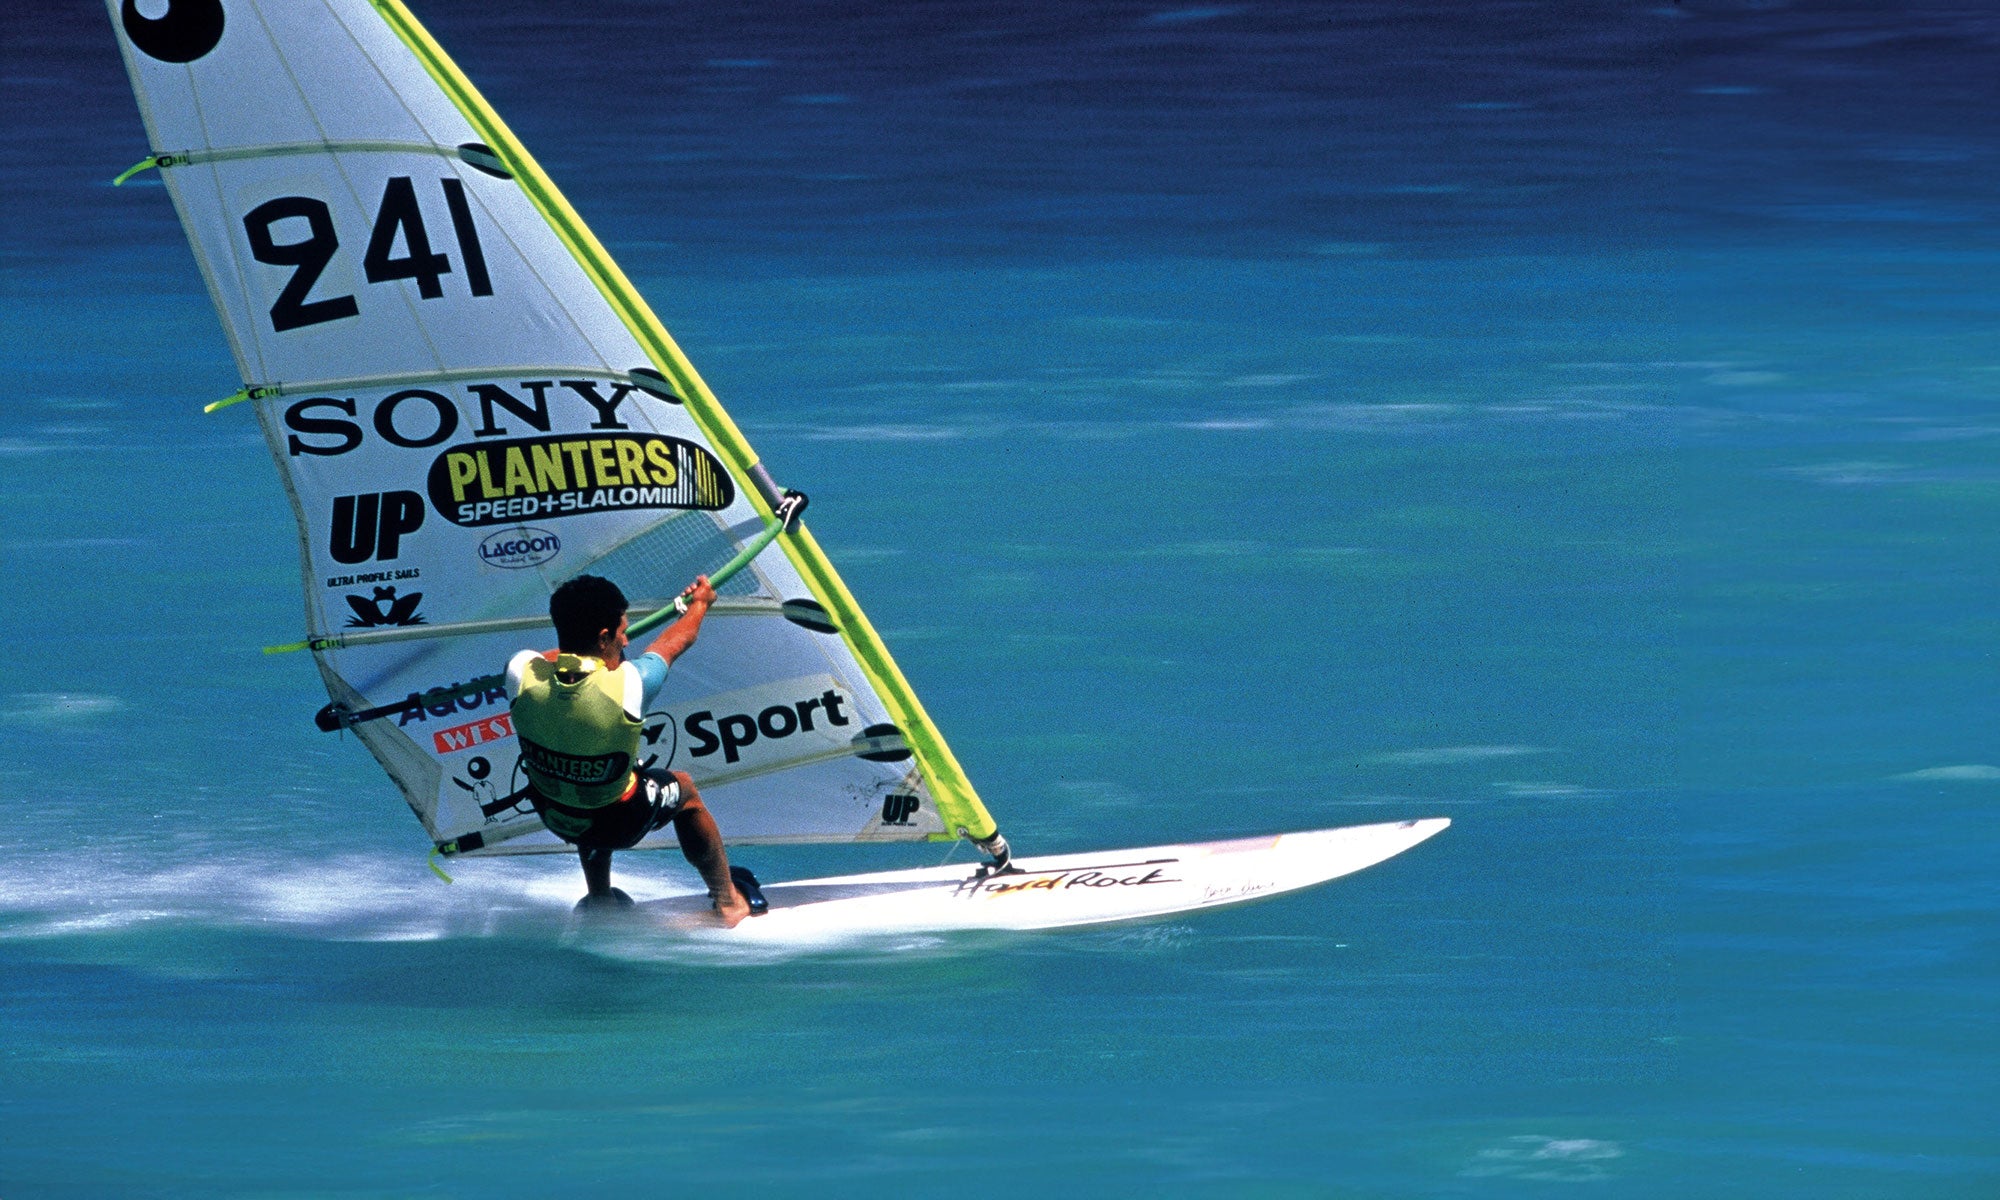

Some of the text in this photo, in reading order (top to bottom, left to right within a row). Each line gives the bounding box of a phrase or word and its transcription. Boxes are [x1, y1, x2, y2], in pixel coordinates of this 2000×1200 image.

[243, 177, 493, 332] 241
[284, 381, 637, 456] SONY
[447, 439, 677, 501] PLANTERS
[330, 490, 425, 564] UP
[327, 568, 420, 587] ULTRA PROFILE SAILS
[684, 690, 848, 764] Sport
[882, 795, 920, 822] UP
